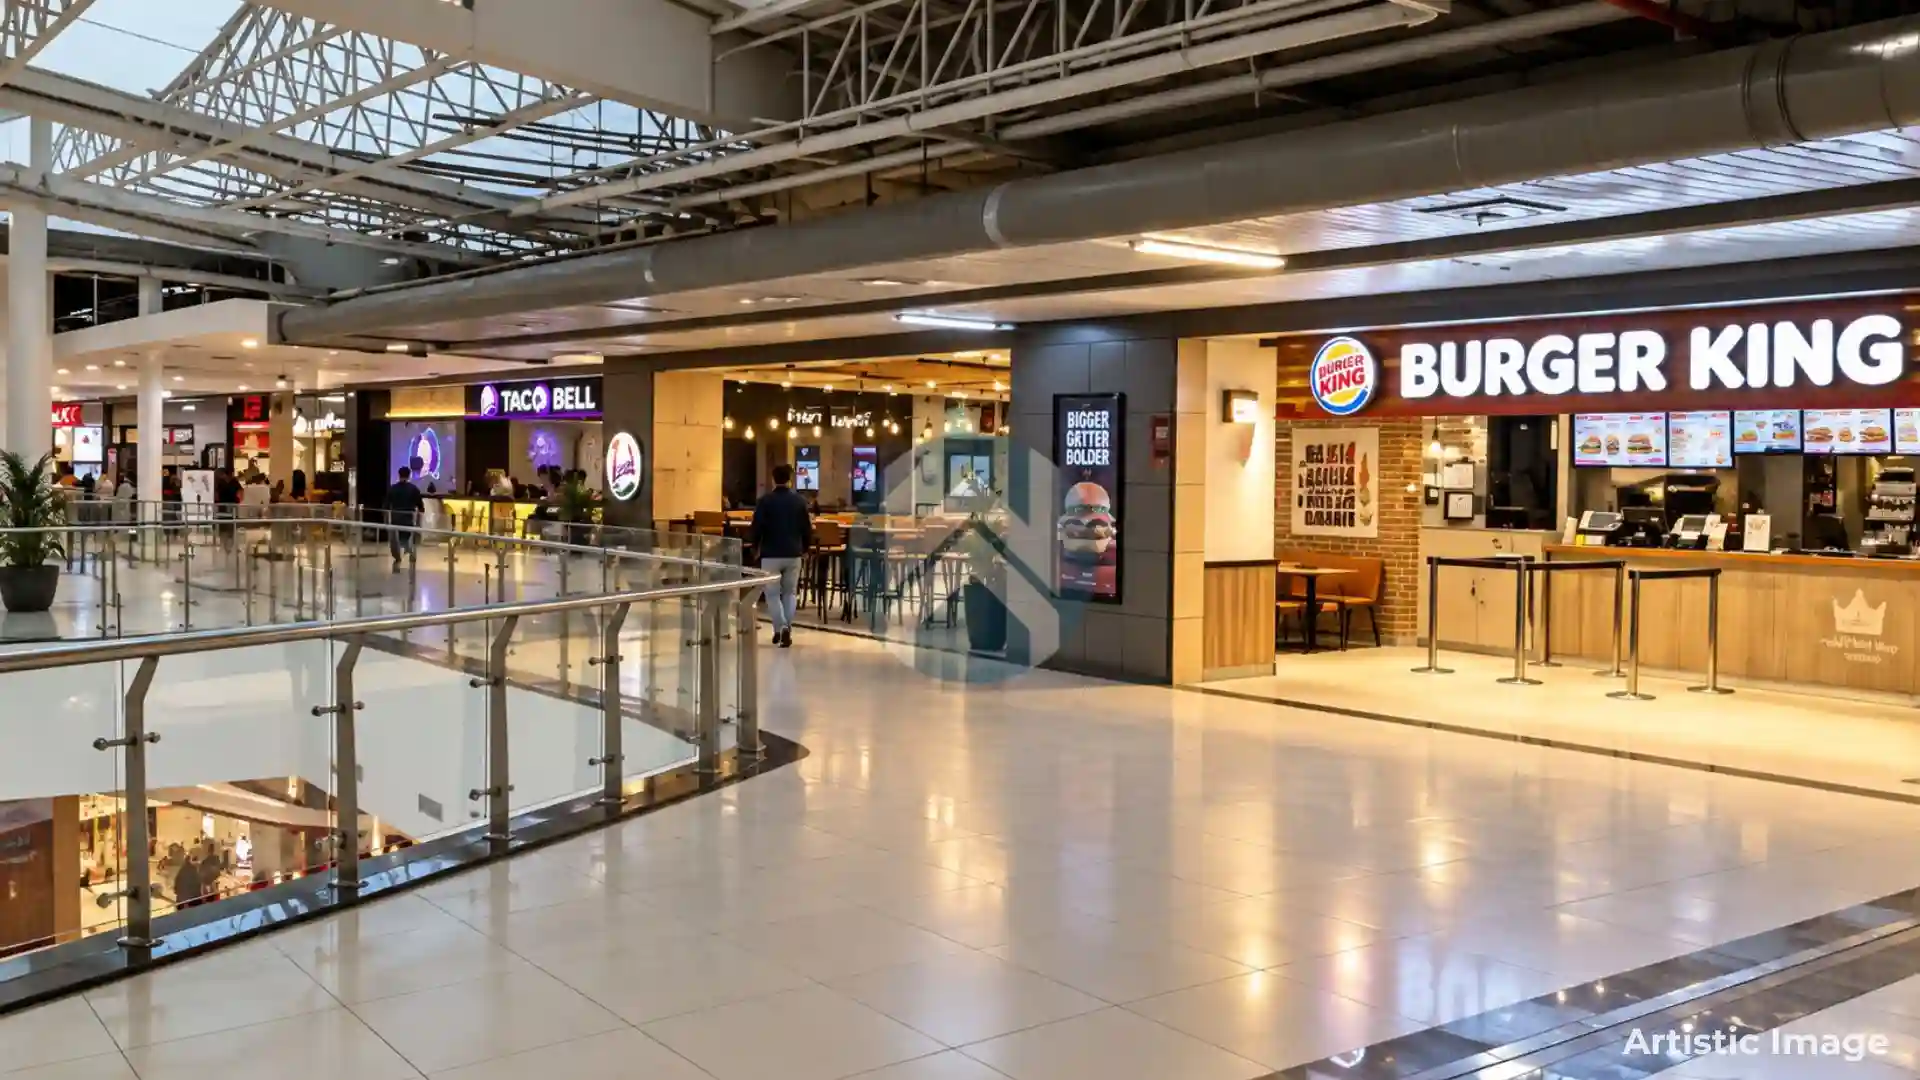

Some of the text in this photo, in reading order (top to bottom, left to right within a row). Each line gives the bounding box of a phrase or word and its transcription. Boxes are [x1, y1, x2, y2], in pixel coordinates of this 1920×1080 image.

[1400, 315, 1903, 399] BURGER KING
[1319, 367, 1366, 397] KING
[501, 386, 596, 413] TACO BELL
[1067, 410, 1110, 429] BIGGER
[1066, 448, 1110, 466] BOLDER
